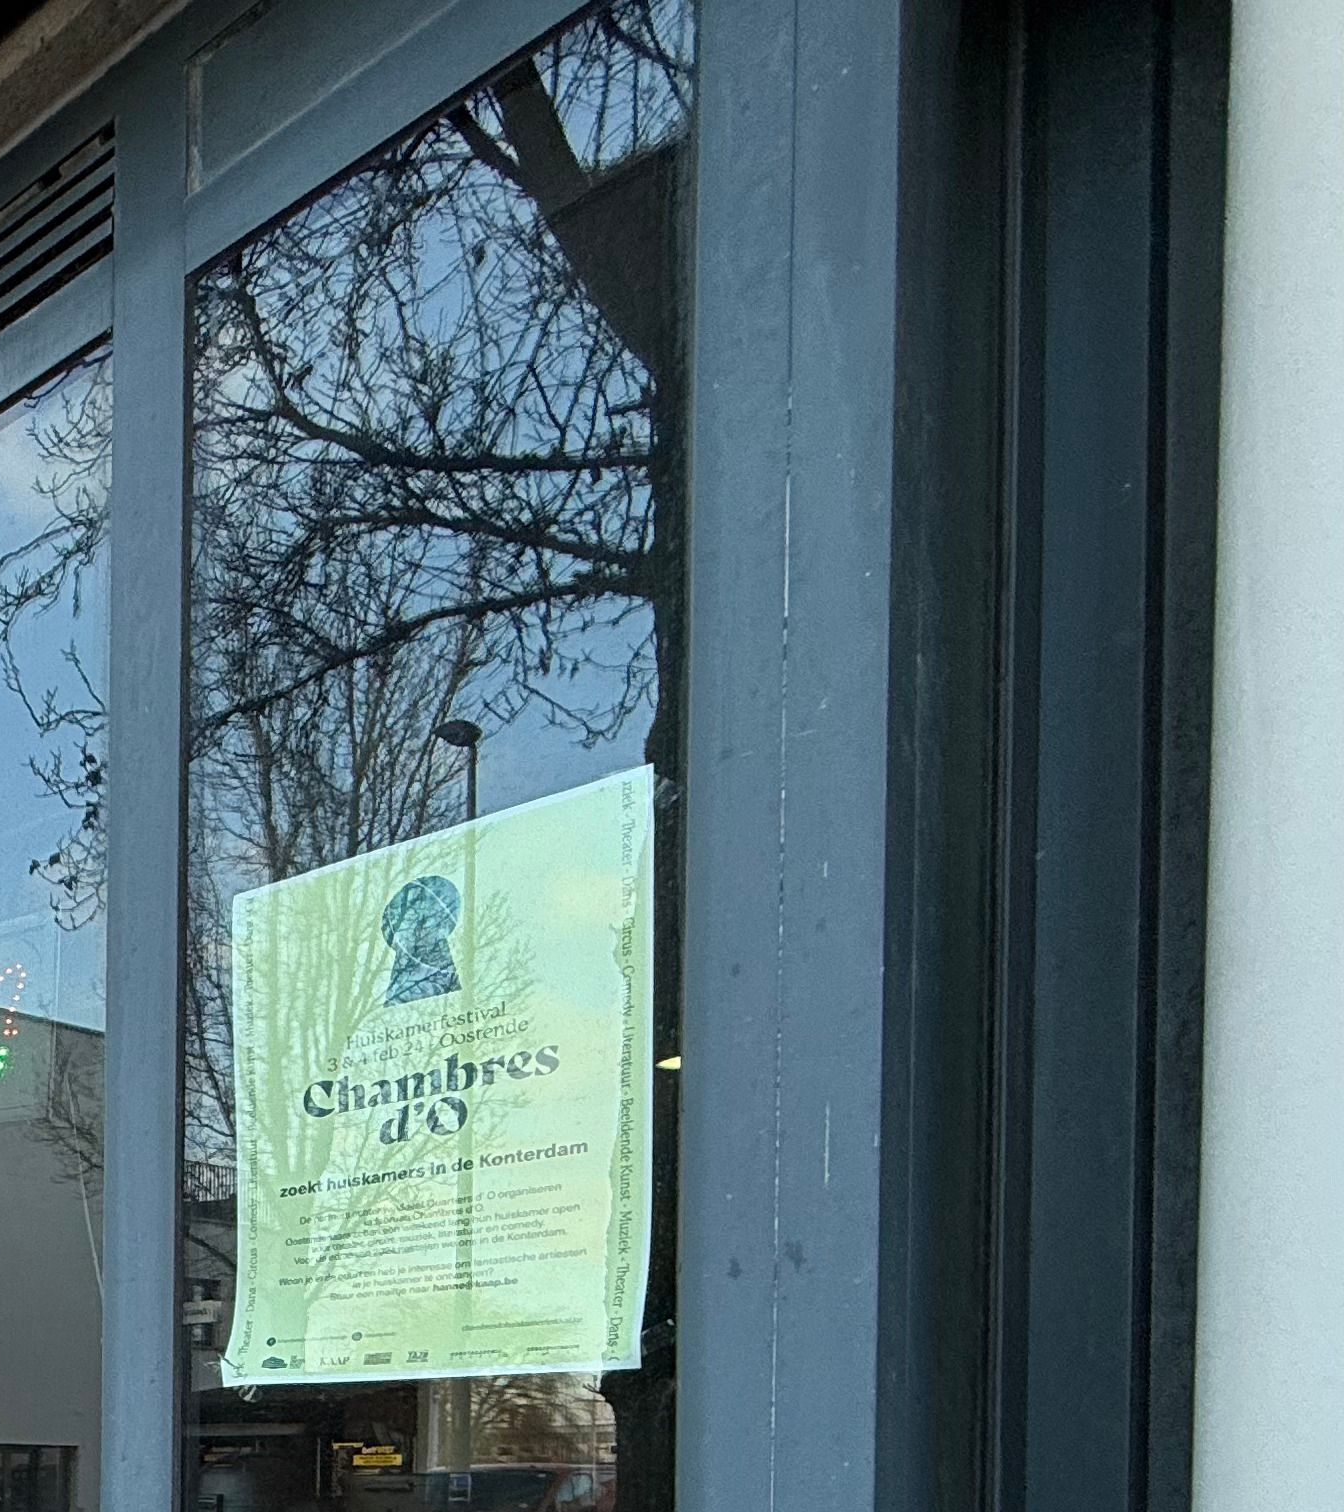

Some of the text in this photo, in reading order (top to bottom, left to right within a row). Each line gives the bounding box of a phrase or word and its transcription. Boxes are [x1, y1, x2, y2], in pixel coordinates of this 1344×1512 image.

[327, 1057, 339, 1073] 3
[373, 1046, 399, 1063] feb
[439, 1018, 530, 1048] Oostende
[346, 1002, 507, 1050] Huiskamerfestival
[303, 1045, 560, 1118] Chambres
[379, 1096, 468, 1145] d'O
[621, 1097, 635, 1162] Beeldende
[279, 1142, 589, 1198] zoekt huiskamers in de Konterdam
[497, 1183, 562, 1198] organiseren
[620, 1164, 634, 1200] Kunst
[494, 1206, 548, 1219] huiskamer
[552, 1203, 580, 1215] open
[617, 1210, 633, 1255] Muziek
[474, 1252, 536, 1265] fantastische
[538, 1247, 587, 1260] artiesten
[612, 1263, 631, 1308] Theater
[237, 1319, 255, 1356] Theater
[607, 1317, 623, 1347] Dans
